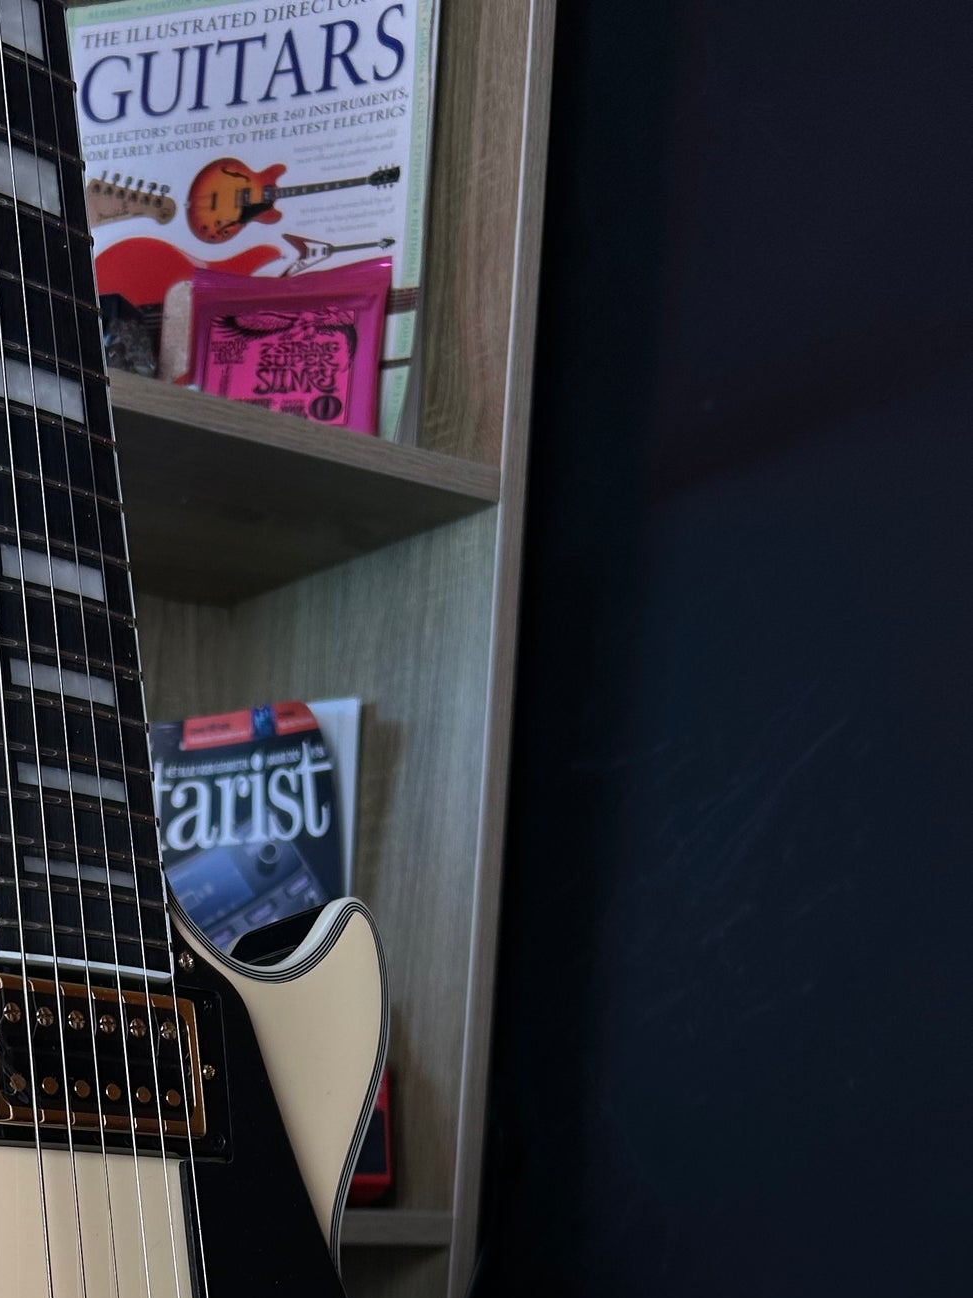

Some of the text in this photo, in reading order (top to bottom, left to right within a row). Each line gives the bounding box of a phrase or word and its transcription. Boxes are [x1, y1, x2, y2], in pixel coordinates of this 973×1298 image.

[82, 0, 368, 49] THE ILLUSTRATED DIRECTO
[81, 3, 406, 124] GUITARS
[112, 144, 154, 159] EARLY
[158, 136, 225, 154] ACOUSTIC
[229, 132, 248, 145] TO
[250, 128, 277, 142] THE
[281, 119, 330, 138] LATEST
[334, 104, 407, 130] ELECTRICS
[174, 120, 215, 136] GUIDE
[220, 116, 240, 130] TO
[242, 111, 279, 127] OVER
[284, 108, 305, 121] 260
[309, 87, 410, 118] INSTRUMENTS,
[253, 367, 338, 394] SLINKY
[259, 354, 340, 369] SUPER
